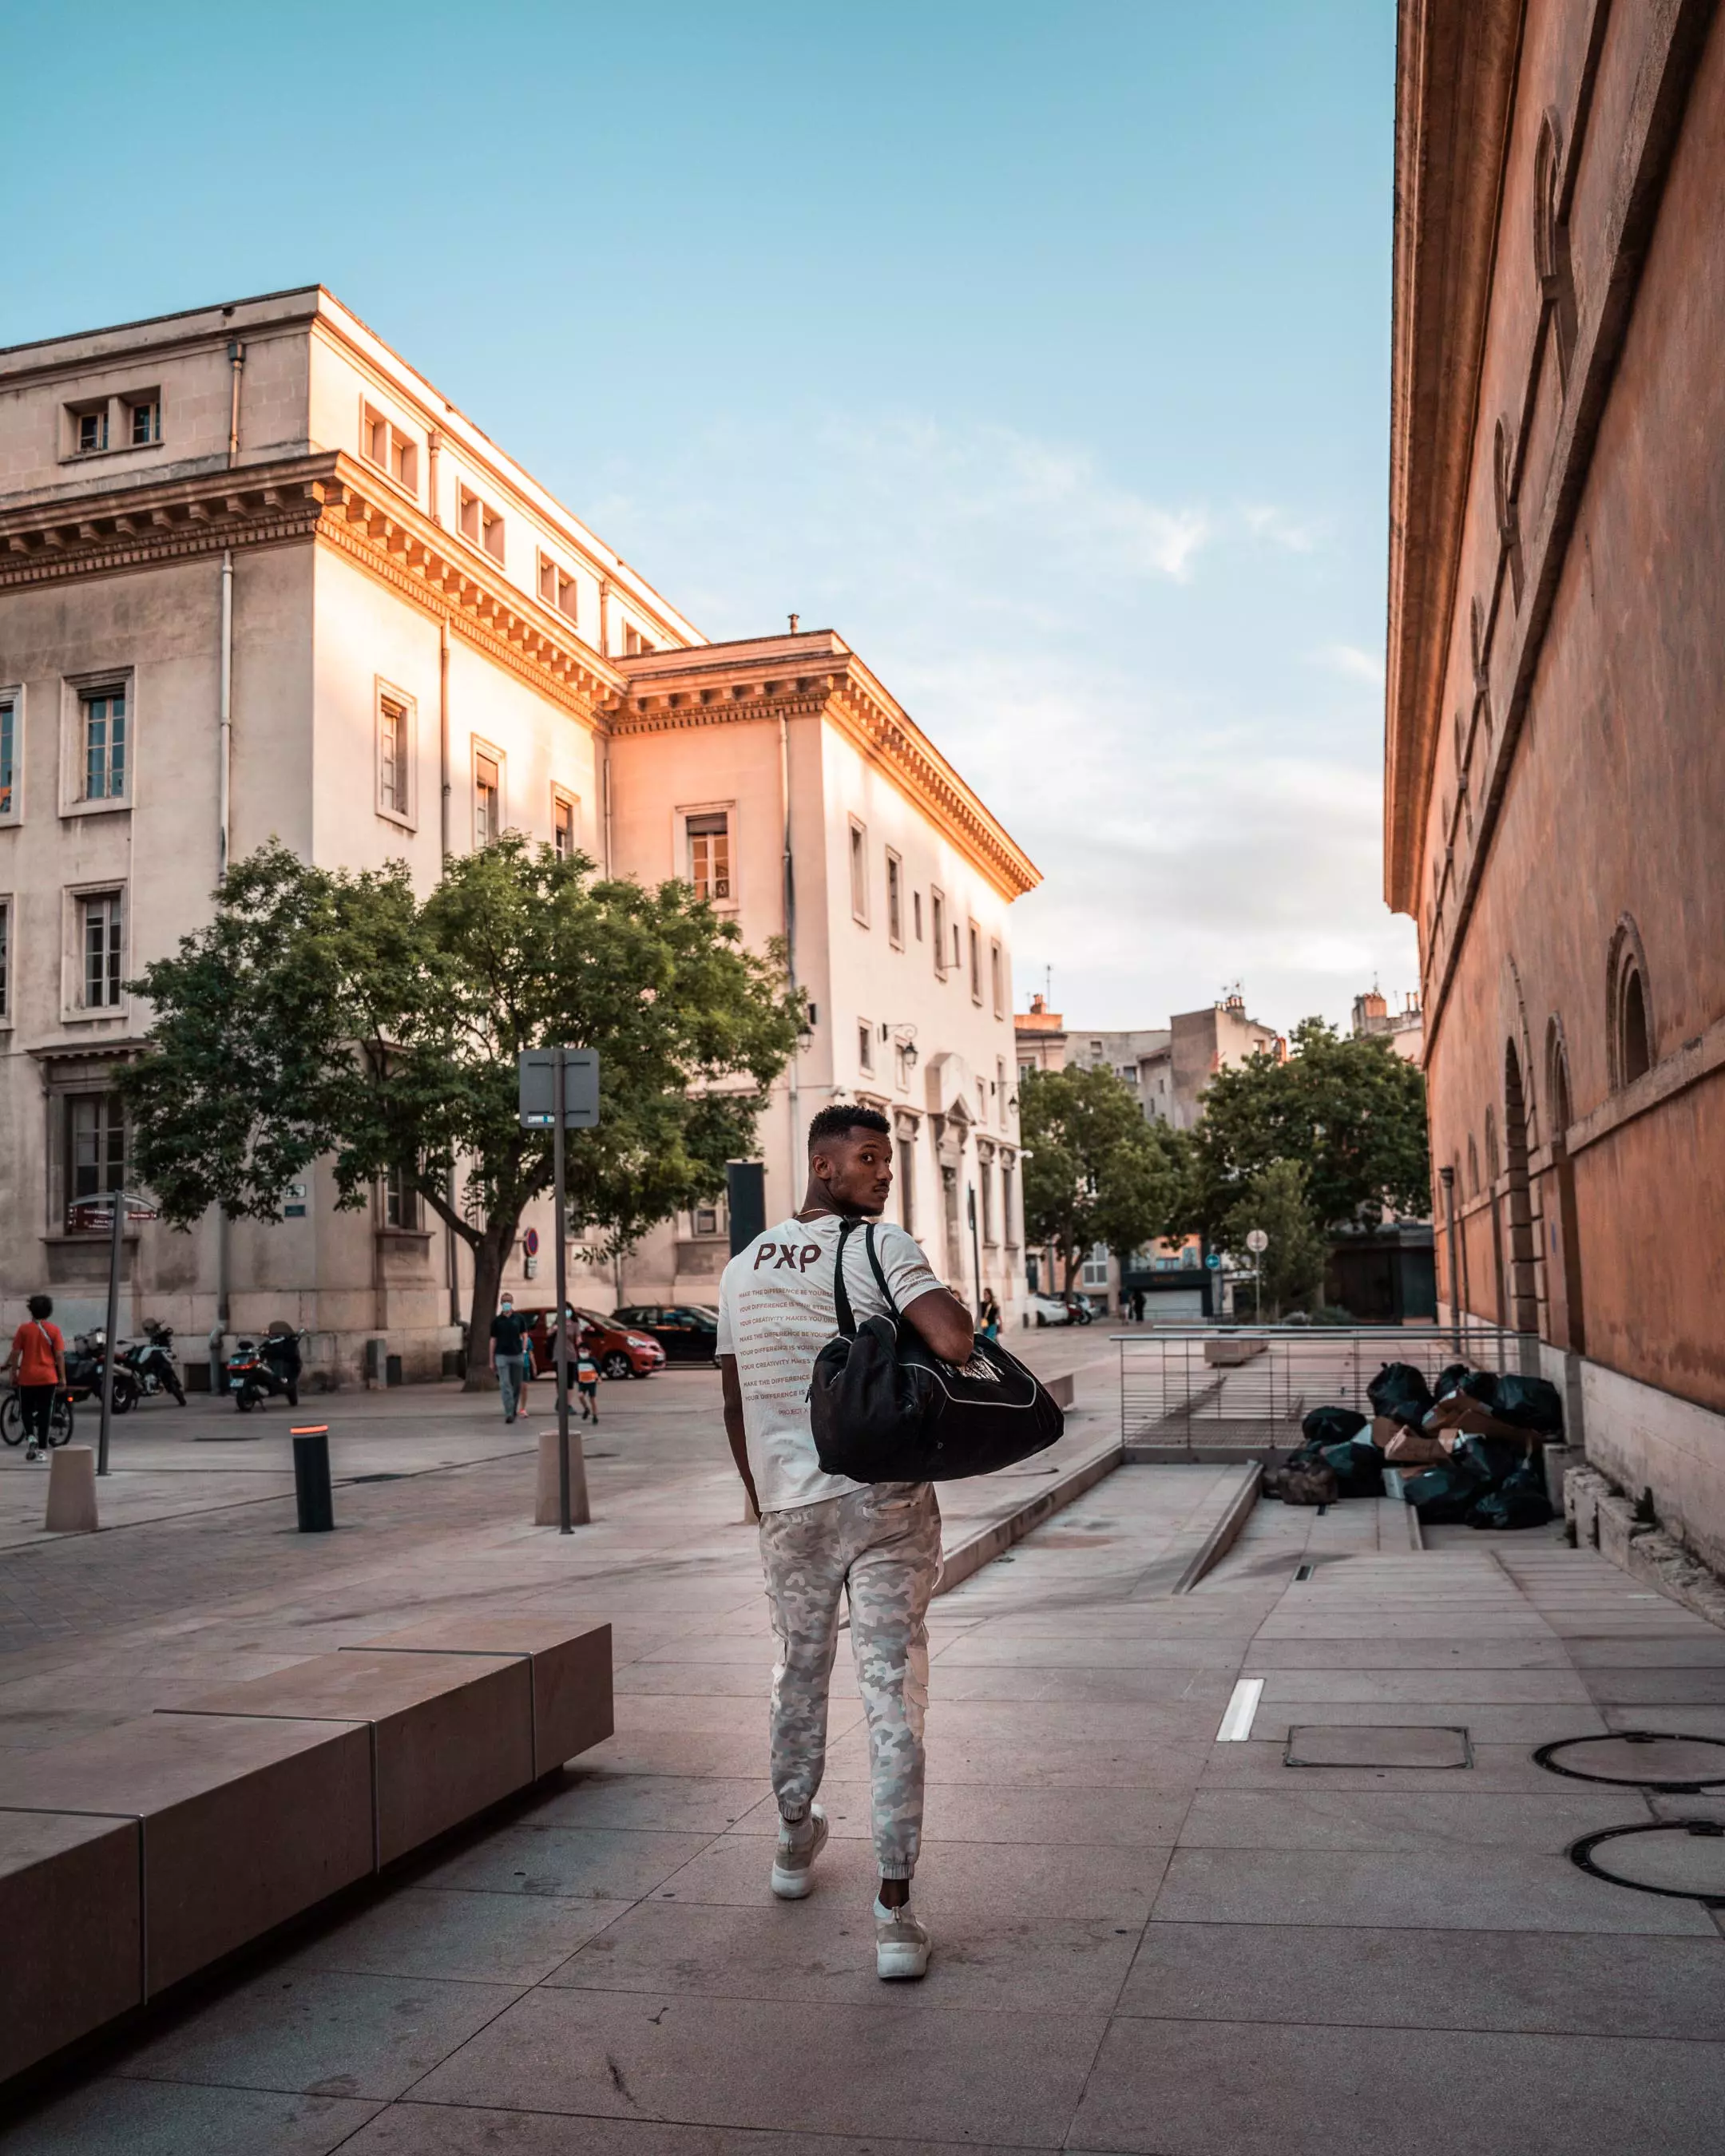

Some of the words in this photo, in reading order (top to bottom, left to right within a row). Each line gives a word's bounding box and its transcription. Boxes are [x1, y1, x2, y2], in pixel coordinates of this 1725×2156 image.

[754, 1243, 822, 1273] PXP
[755, 1358, 790, 1368] CREATIVITY
[771, 1374, 811, 1385] DIFFERENCE
